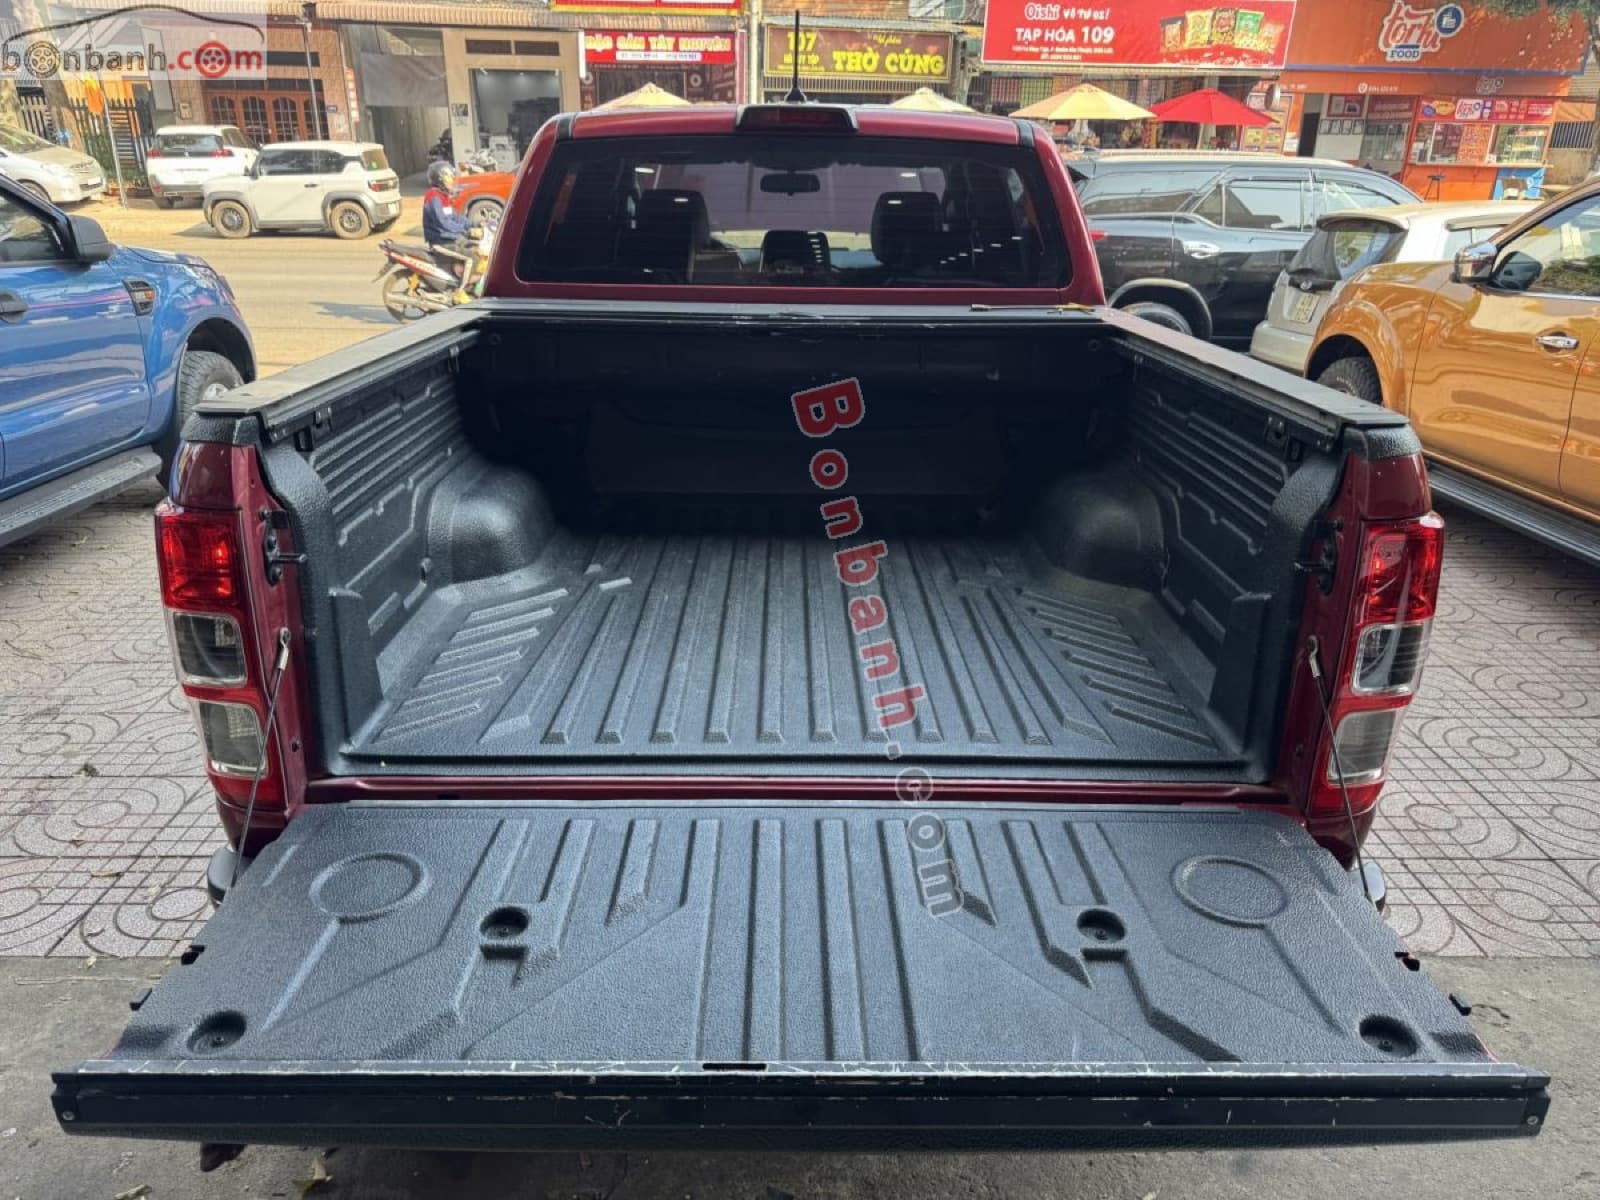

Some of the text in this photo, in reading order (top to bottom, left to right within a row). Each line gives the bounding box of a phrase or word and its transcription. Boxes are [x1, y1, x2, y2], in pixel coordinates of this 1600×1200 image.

[1024, 2, 1061, 20] Oishi
[1016, 26, 1115, 44] TẠP HÓA 109
[832, 47, 879, 72] THỜ
[885, 49, 945, 74] CÚNG
[1390, 50, 1420, 58] FOOD
